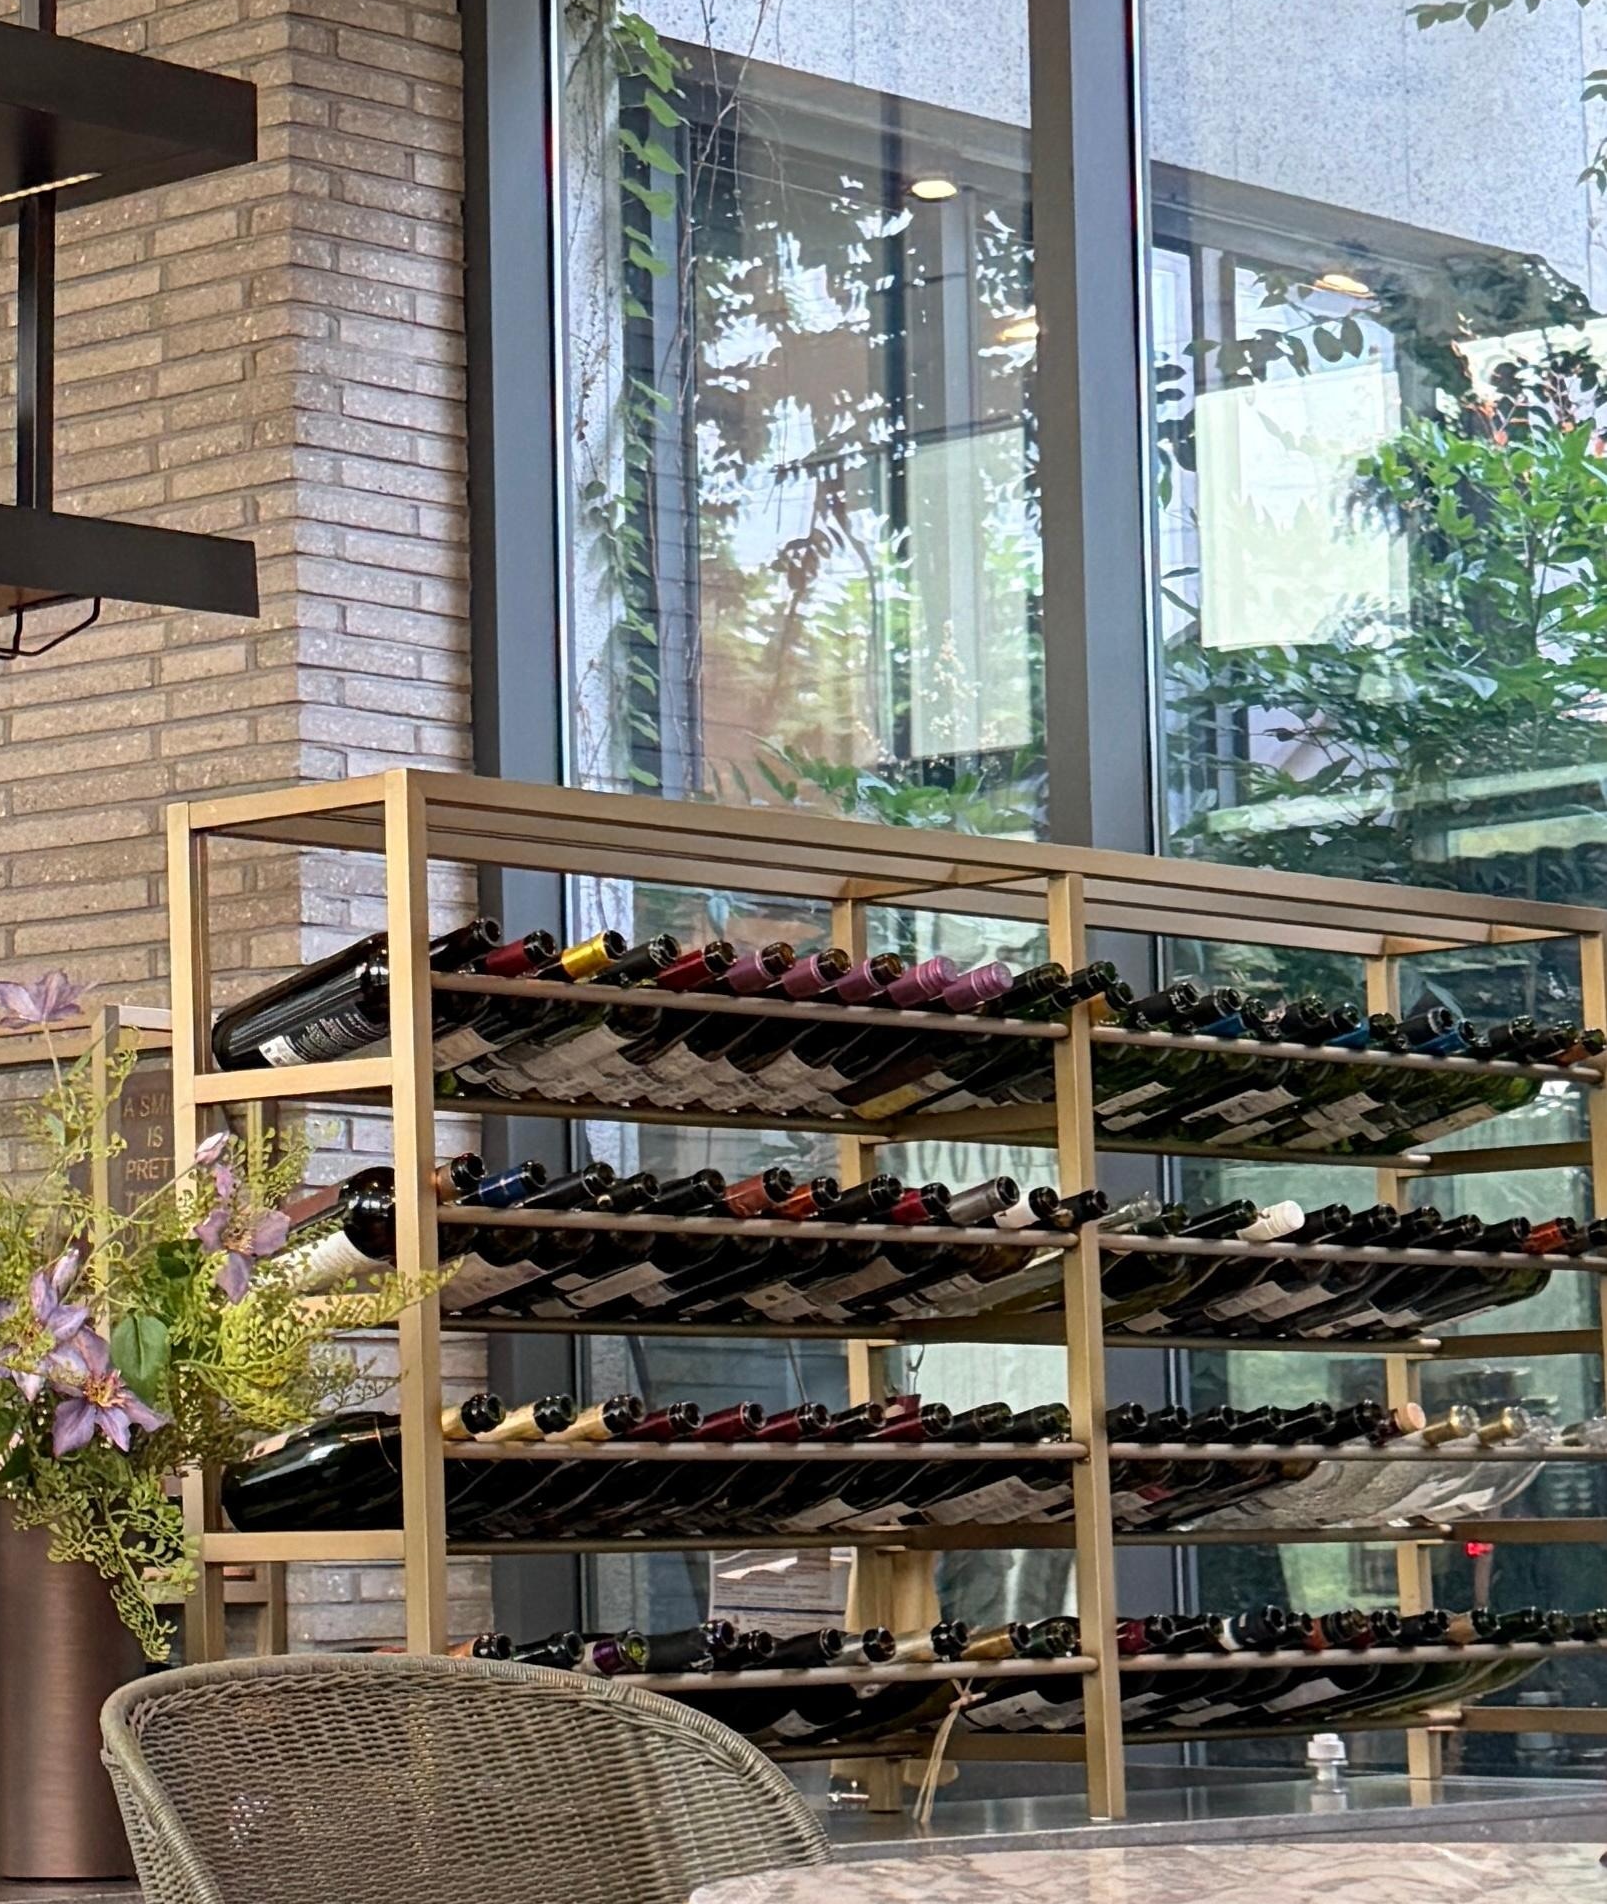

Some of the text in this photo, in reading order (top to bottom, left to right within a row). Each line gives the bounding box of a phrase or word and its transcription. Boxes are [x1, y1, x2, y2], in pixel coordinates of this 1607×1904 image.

[124, 1094, 170, 1117] A SMI
[147, 1125, 163, 1147] IS
[124, 1158, 172, 1181] PRET
